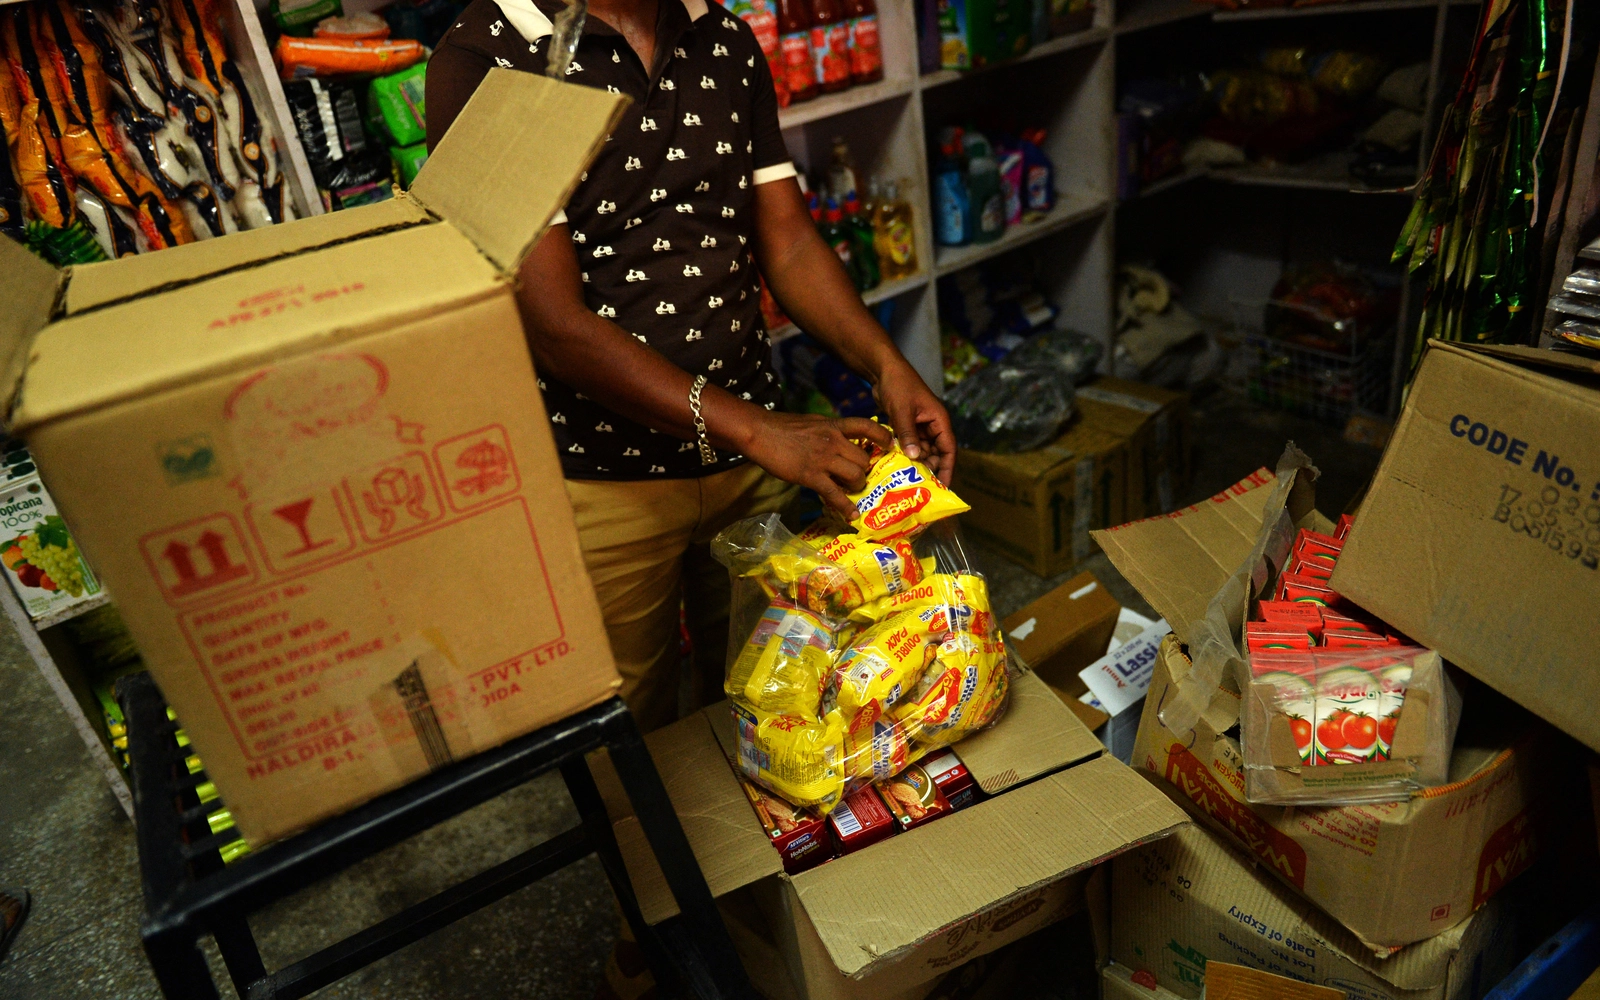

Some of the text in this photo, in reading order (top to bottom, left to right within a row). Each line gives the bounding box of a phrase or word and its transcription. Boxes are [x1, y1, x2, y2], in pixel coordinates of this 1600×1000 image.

[1450, 414, 1528, 465] CODE
[1532, 450, 1580, 492] No.
[0, 497, 42, 516] opicana
[2, 510, 42, 529] 100%
[873, 487, 924, 526] Maggi
[826, 542, 855, 562] DOUB
[891, 585, 934, 607] DOUBLE
[201, 608, 292, 649] QUANTITY
[885, 627, 908, 651] PACK
[334, 637, 386, 664] PRICE
[893, 633, 921, 662] DOUBLE
[1115, 642, 1160, 677] Lassi
[482, 661, 530, 689] PVT.
[534, 642, 576, 668] LTD.
[1320, 684, 1368, 701] Safal
[1381, 678, 1407, 697] Saf
[1196, 767, 1235, 812] NOODLES
[1311, 829, 1373, 857] Manufactured
[1326, 823, 1356, 841] Foods
[1360, 838, 1376, 847] CG
[1228, 905, 1315, 958] Date of Expiry
[1218, 932, 1266, 969] Packing
[1268, 946, 1315, 973] Lot No.
[1266, 961, 1283, 976] of
